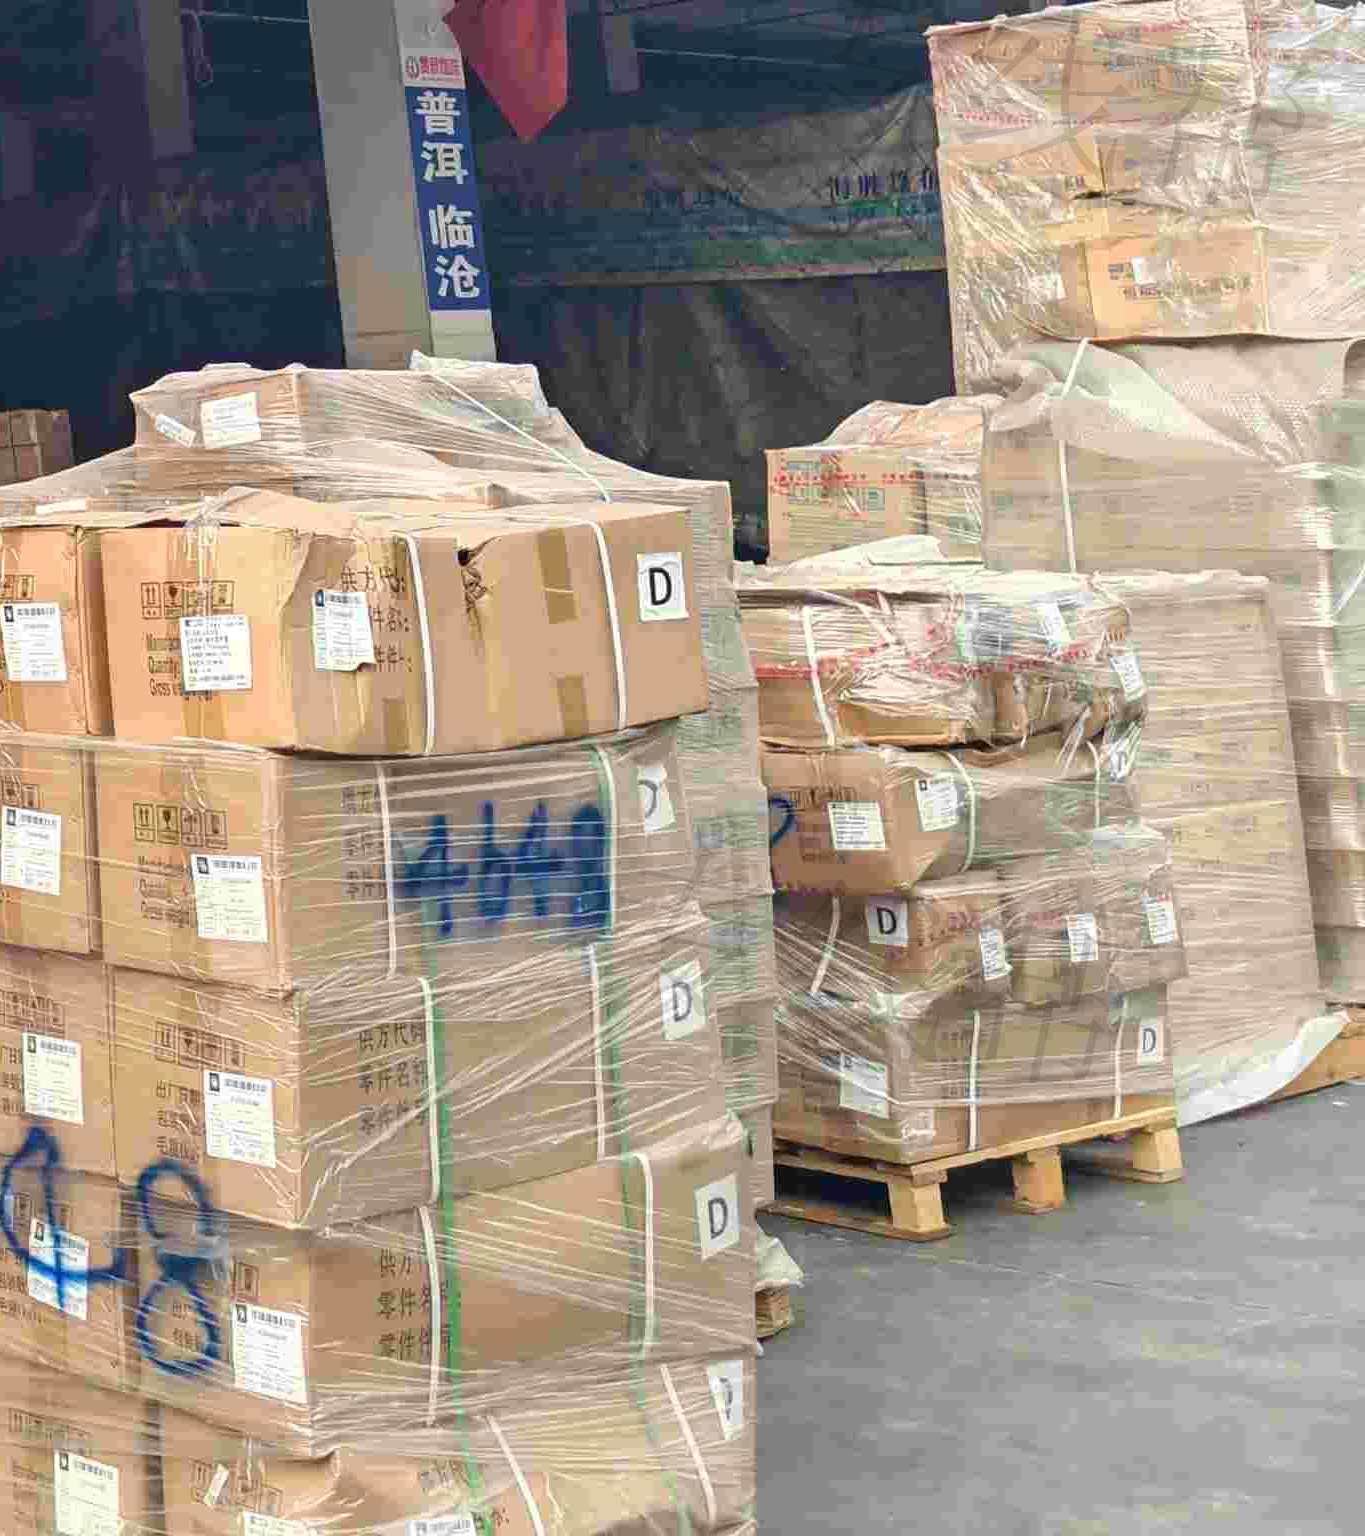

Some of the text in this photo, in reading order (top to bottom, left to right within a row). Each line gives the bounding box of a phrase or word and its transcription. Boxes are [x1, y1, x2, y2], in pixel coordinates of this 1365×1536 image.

[415, 90, 469, 185] 普洱
[427, 203, 481, 298] 临沧
[649, 566, 672, 607] D
[876, 906, 897, 935] D
[671, 981, 693, 1023] D
[1142, 1027, 1157, 1053] D
[708, 1196, 732, 1239] D
